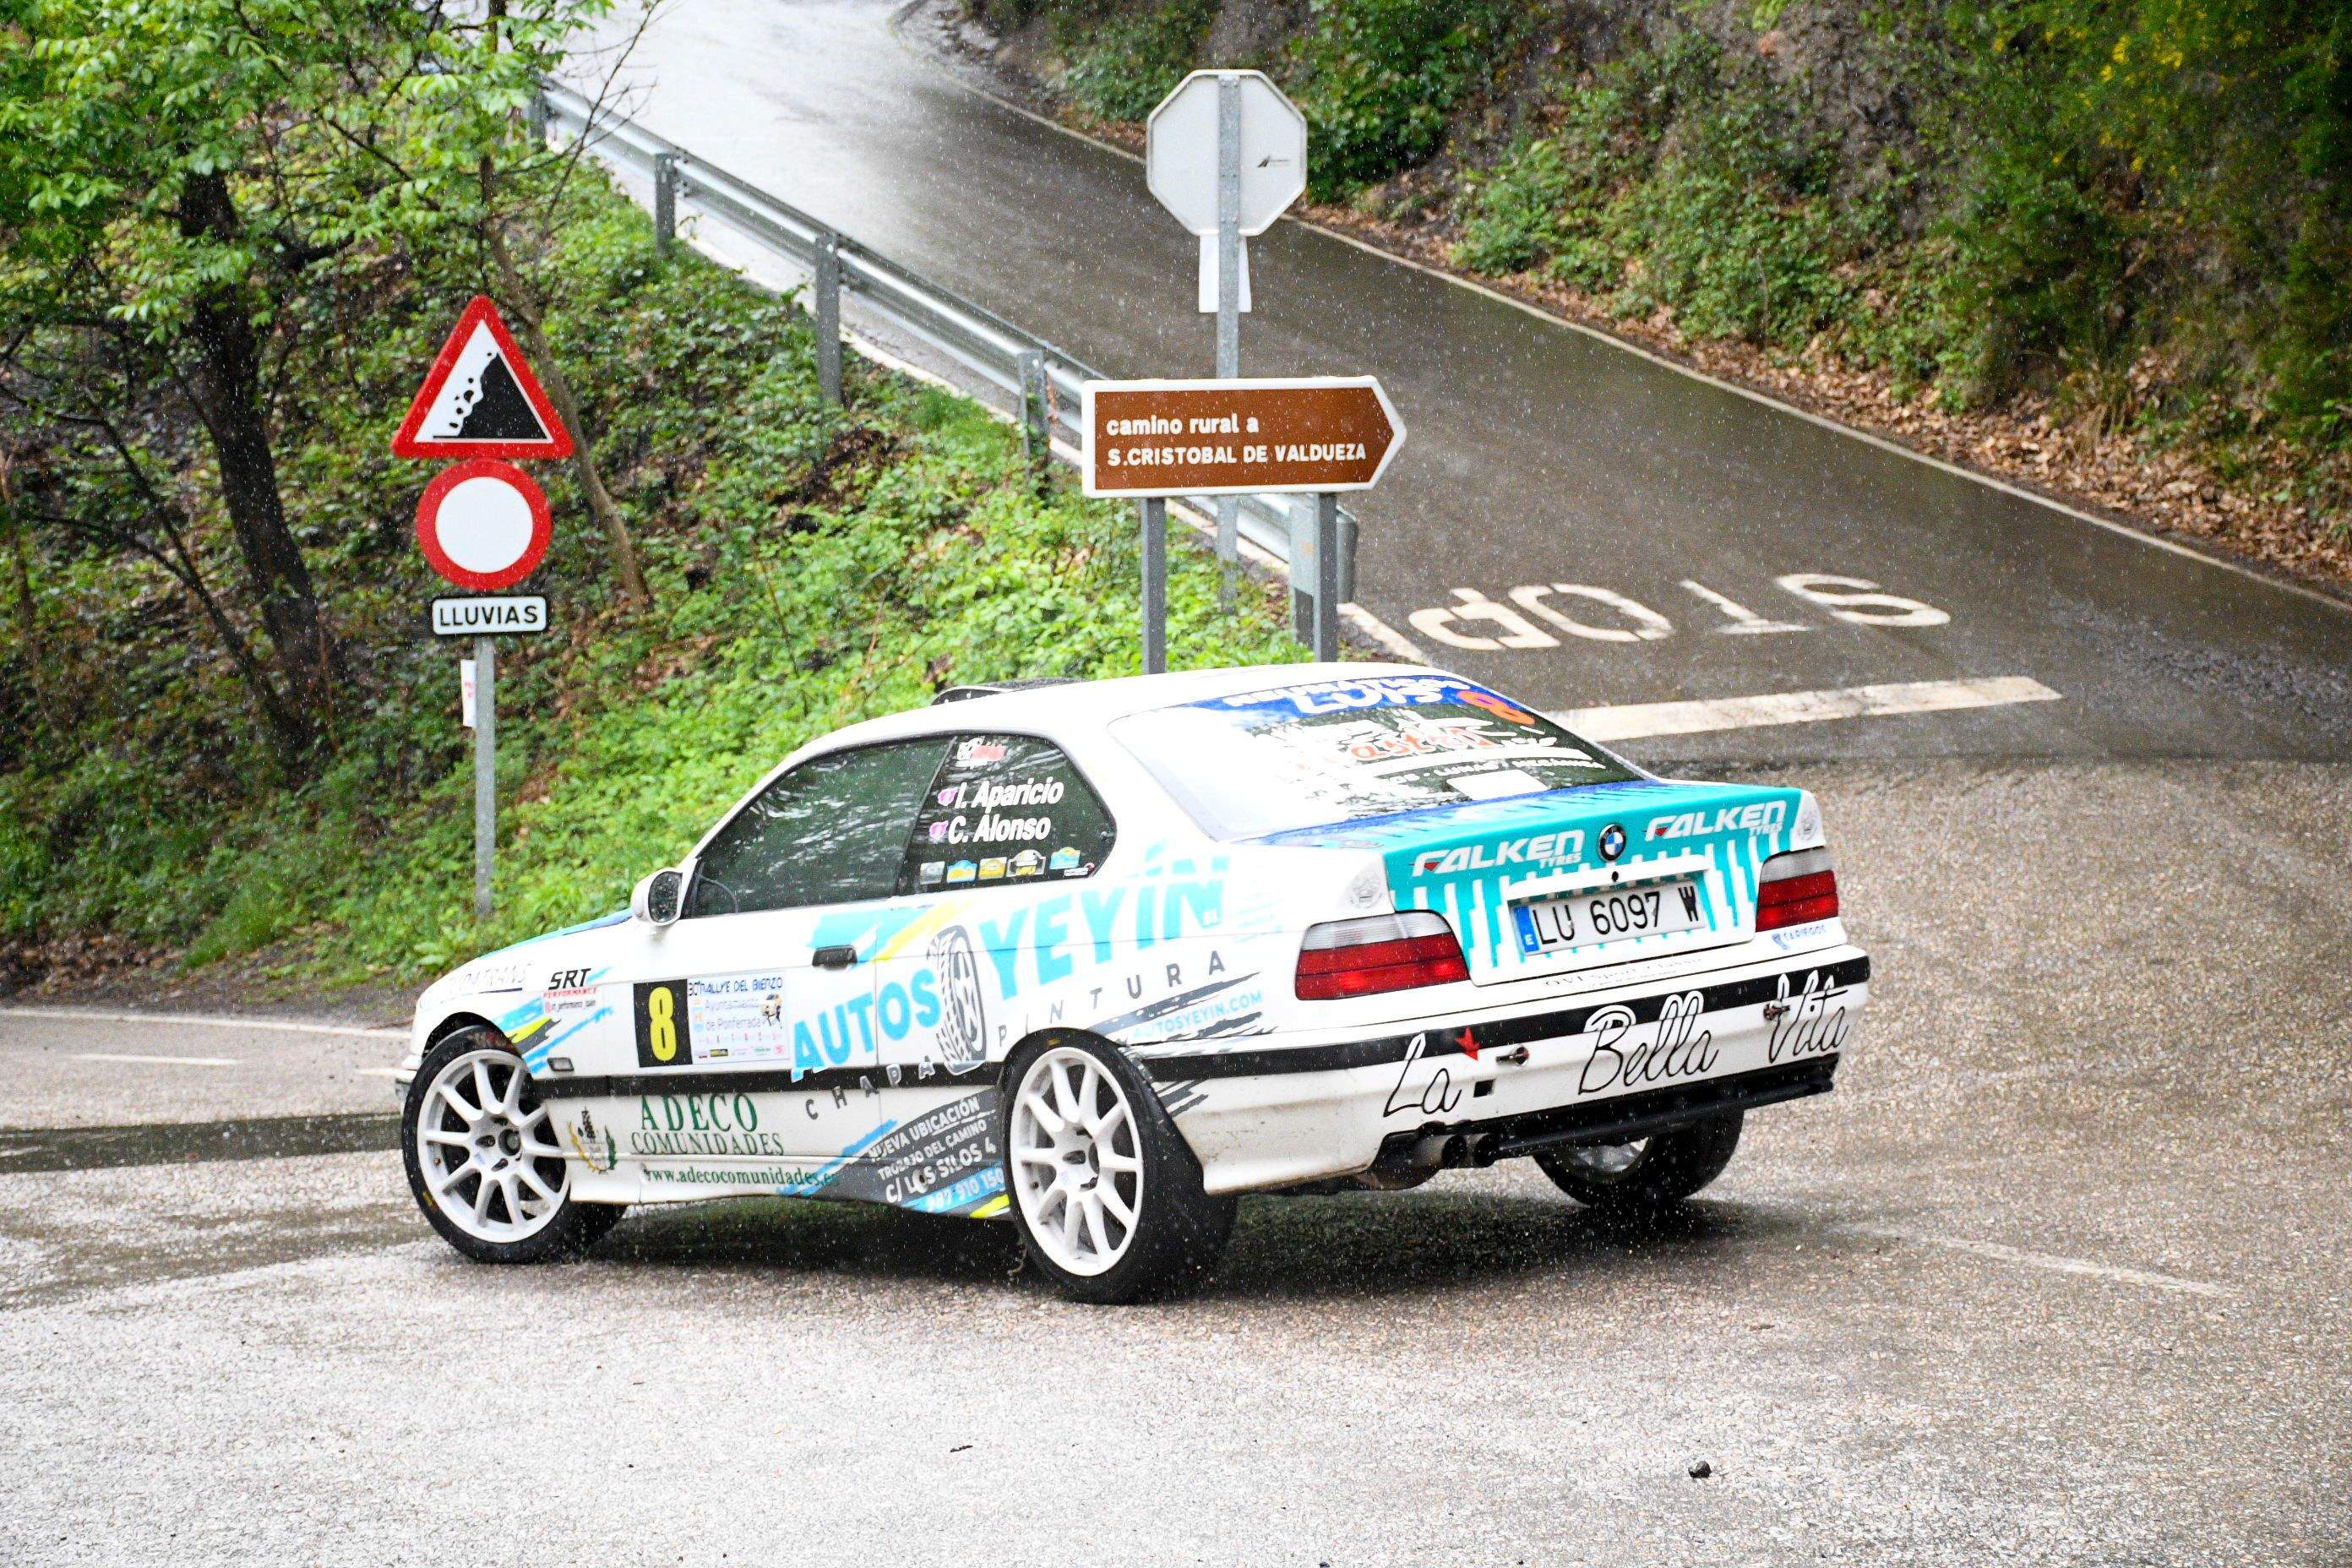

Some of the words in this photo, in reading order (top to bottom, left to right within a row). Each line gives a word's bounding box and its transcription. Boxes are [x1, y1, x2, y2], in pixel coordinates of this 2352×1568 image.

[1106, 414, 1183, 436] camino
[1189, 412, 1240, 434] rural
[1245, 417, 1260, 433] a
[1107, 445, 1237, 467] S.CRISTOBAL
[1243, 444, 1267, 464] DE
[1274, 443, 1367, 463] VALDUEZA
[438, 604, 539, 629] LLUVIAS
[1407, 573, 1951, 651] STOP
[954, 781, 968, 809] I.
[971, 776, 1064, 814] Aparicio
[947, 815, 969, 844] C.
[972, 814, 1052, 843] Alonso
[1645, 799, 1787, 842] FALKEN
[1411, 829, 1585, 878] FALKEN
[1538, 852, 1582, 869] TYRES
[1533, 904, 1576, 945] LU
[1589, 891, 1661, 936] 6097
[1678, 886, 1700, 923] W
[548, 968, 591, 991] SRT
[733, 978, 749, 992] DEL
[649, 986, 677, 1062] 8
[791, 968, 941, 1083] AUTOS
[1382, 1032, 1462, 1118] La
[1577, 988, 1718, 1096] Bella
[1767, 969, 1849, 1064] Vita
[640, 1094, 759, 1133] ADECO
[868, 1130, 911, 1162] NUEVA
[908, 1096, 981, 1141] UBICACIÓN
[631, 1131, 785, 1157] COMUNIDADES
[923, 1140, 946, 1158] DEL
[945, 1119, 988, 1148] CAMINO
[885, 1176, 902, 1203] C/
[903, 1165, 937, 1195] LOS
[936, 1142, 983, 1179] SILOS
[984, 1135, 998, 1155] 4
